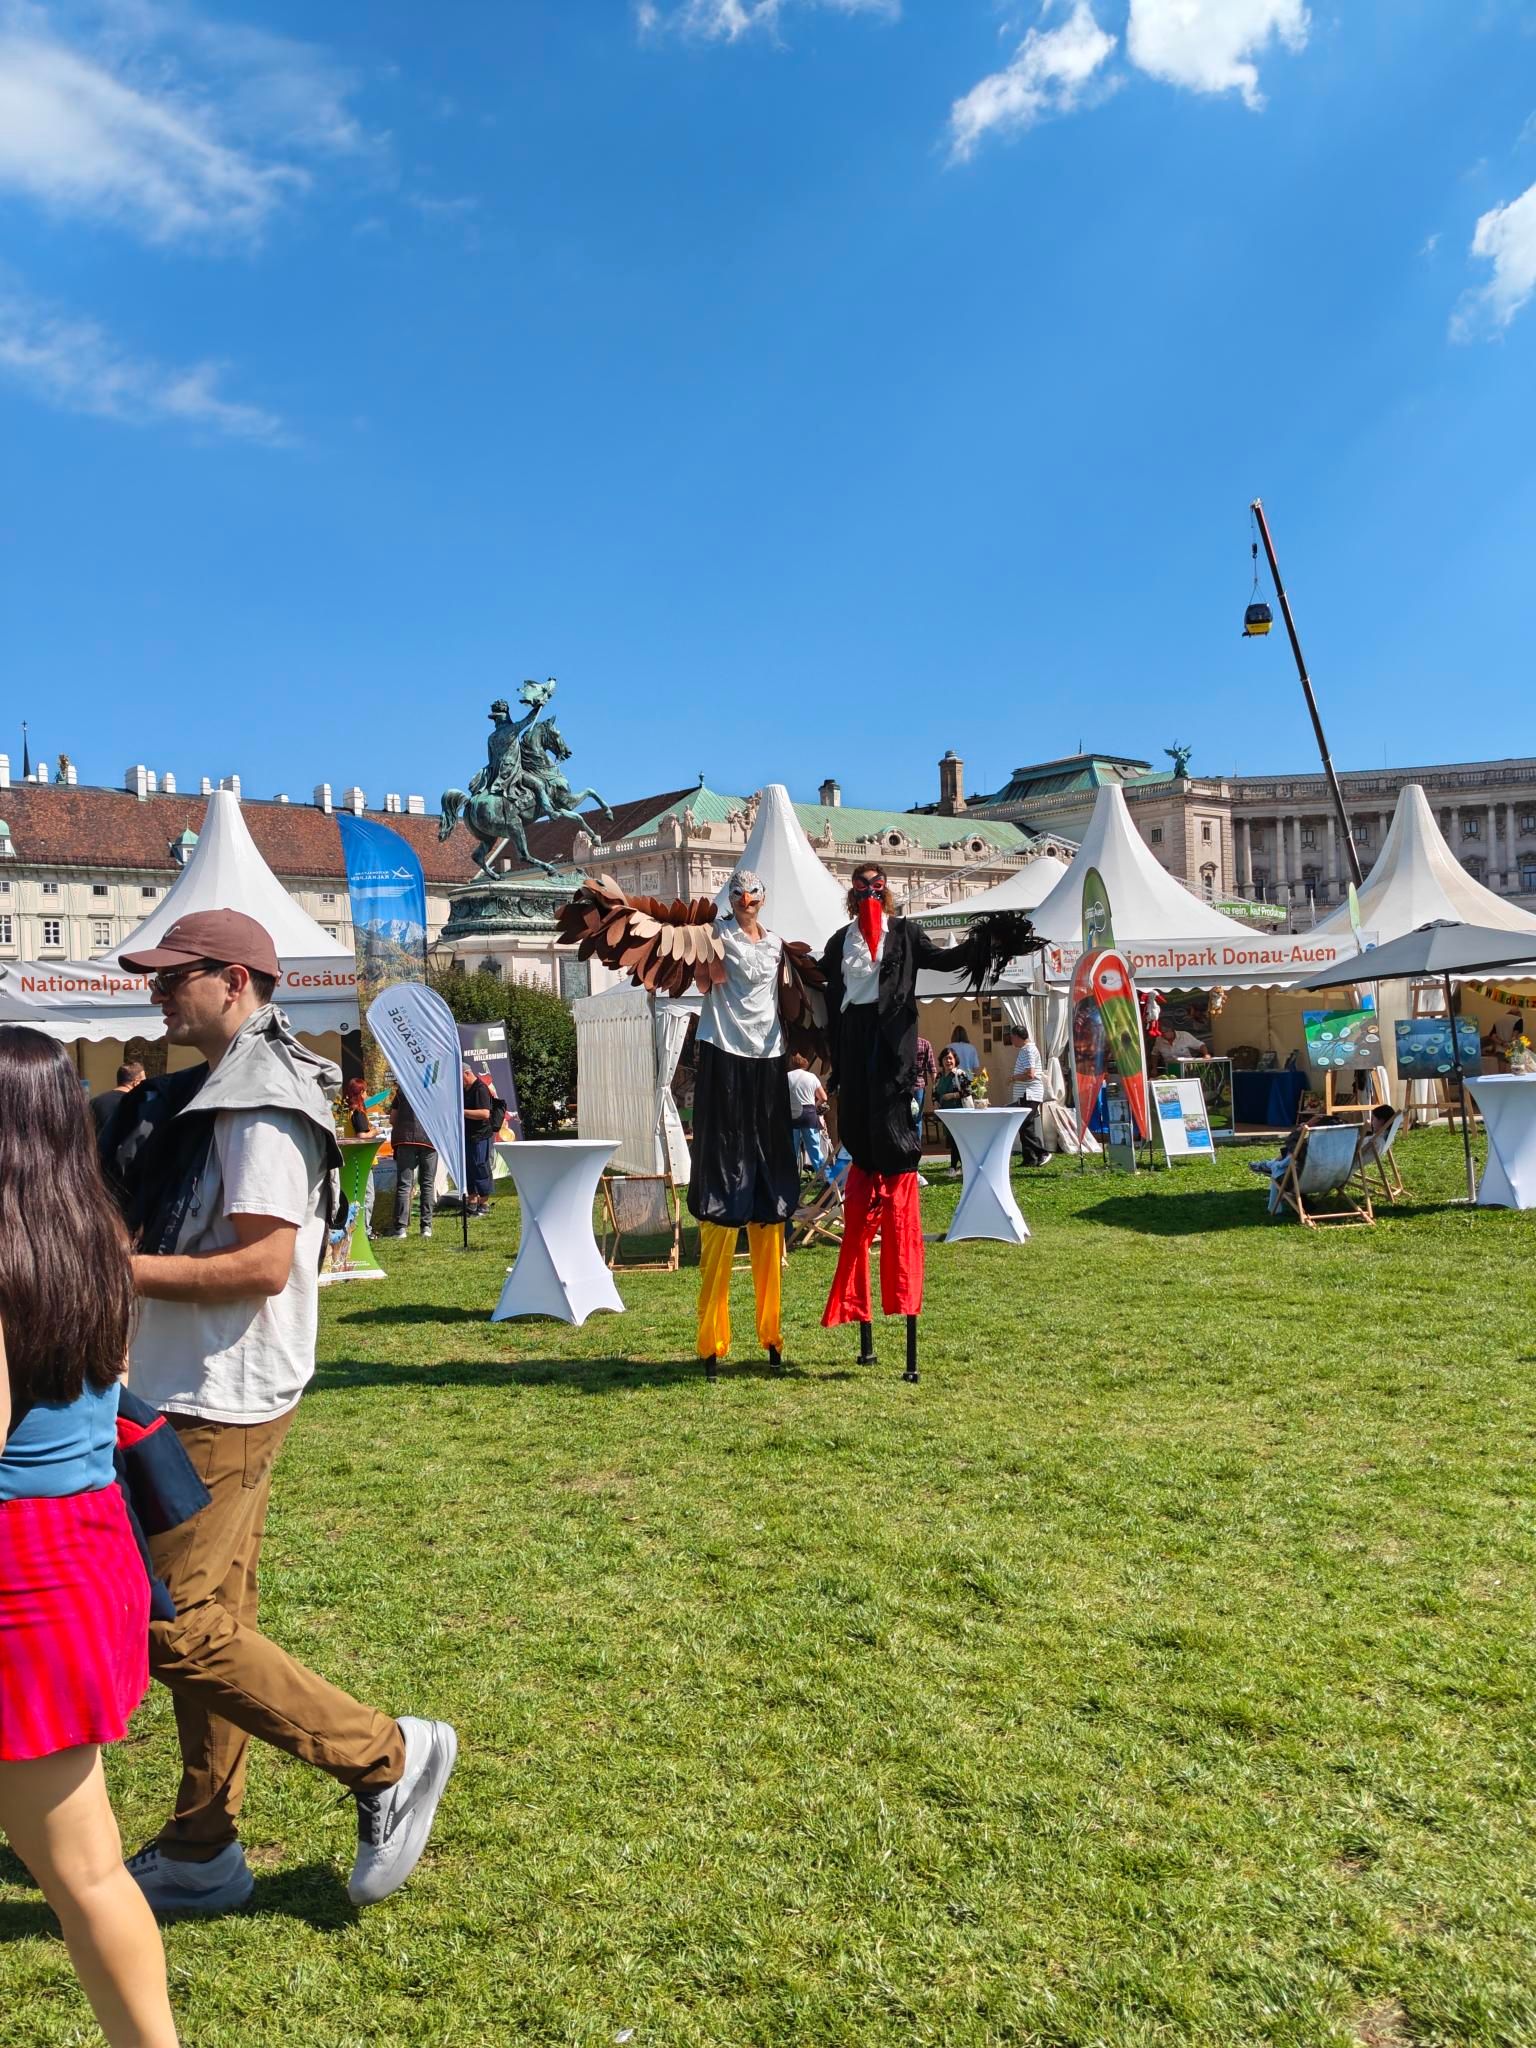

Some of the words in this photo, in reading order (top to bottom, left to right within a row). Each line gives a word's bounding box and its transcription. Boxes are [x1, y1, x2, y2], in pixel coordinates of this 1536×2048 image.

[916, 917, 960, 928] Produkte
[1127, 948, 1217, 972] ionalpark
[1223, 945, 1336, 965] Donau-Auen
[286, 970, 357, 987] Gesäus
